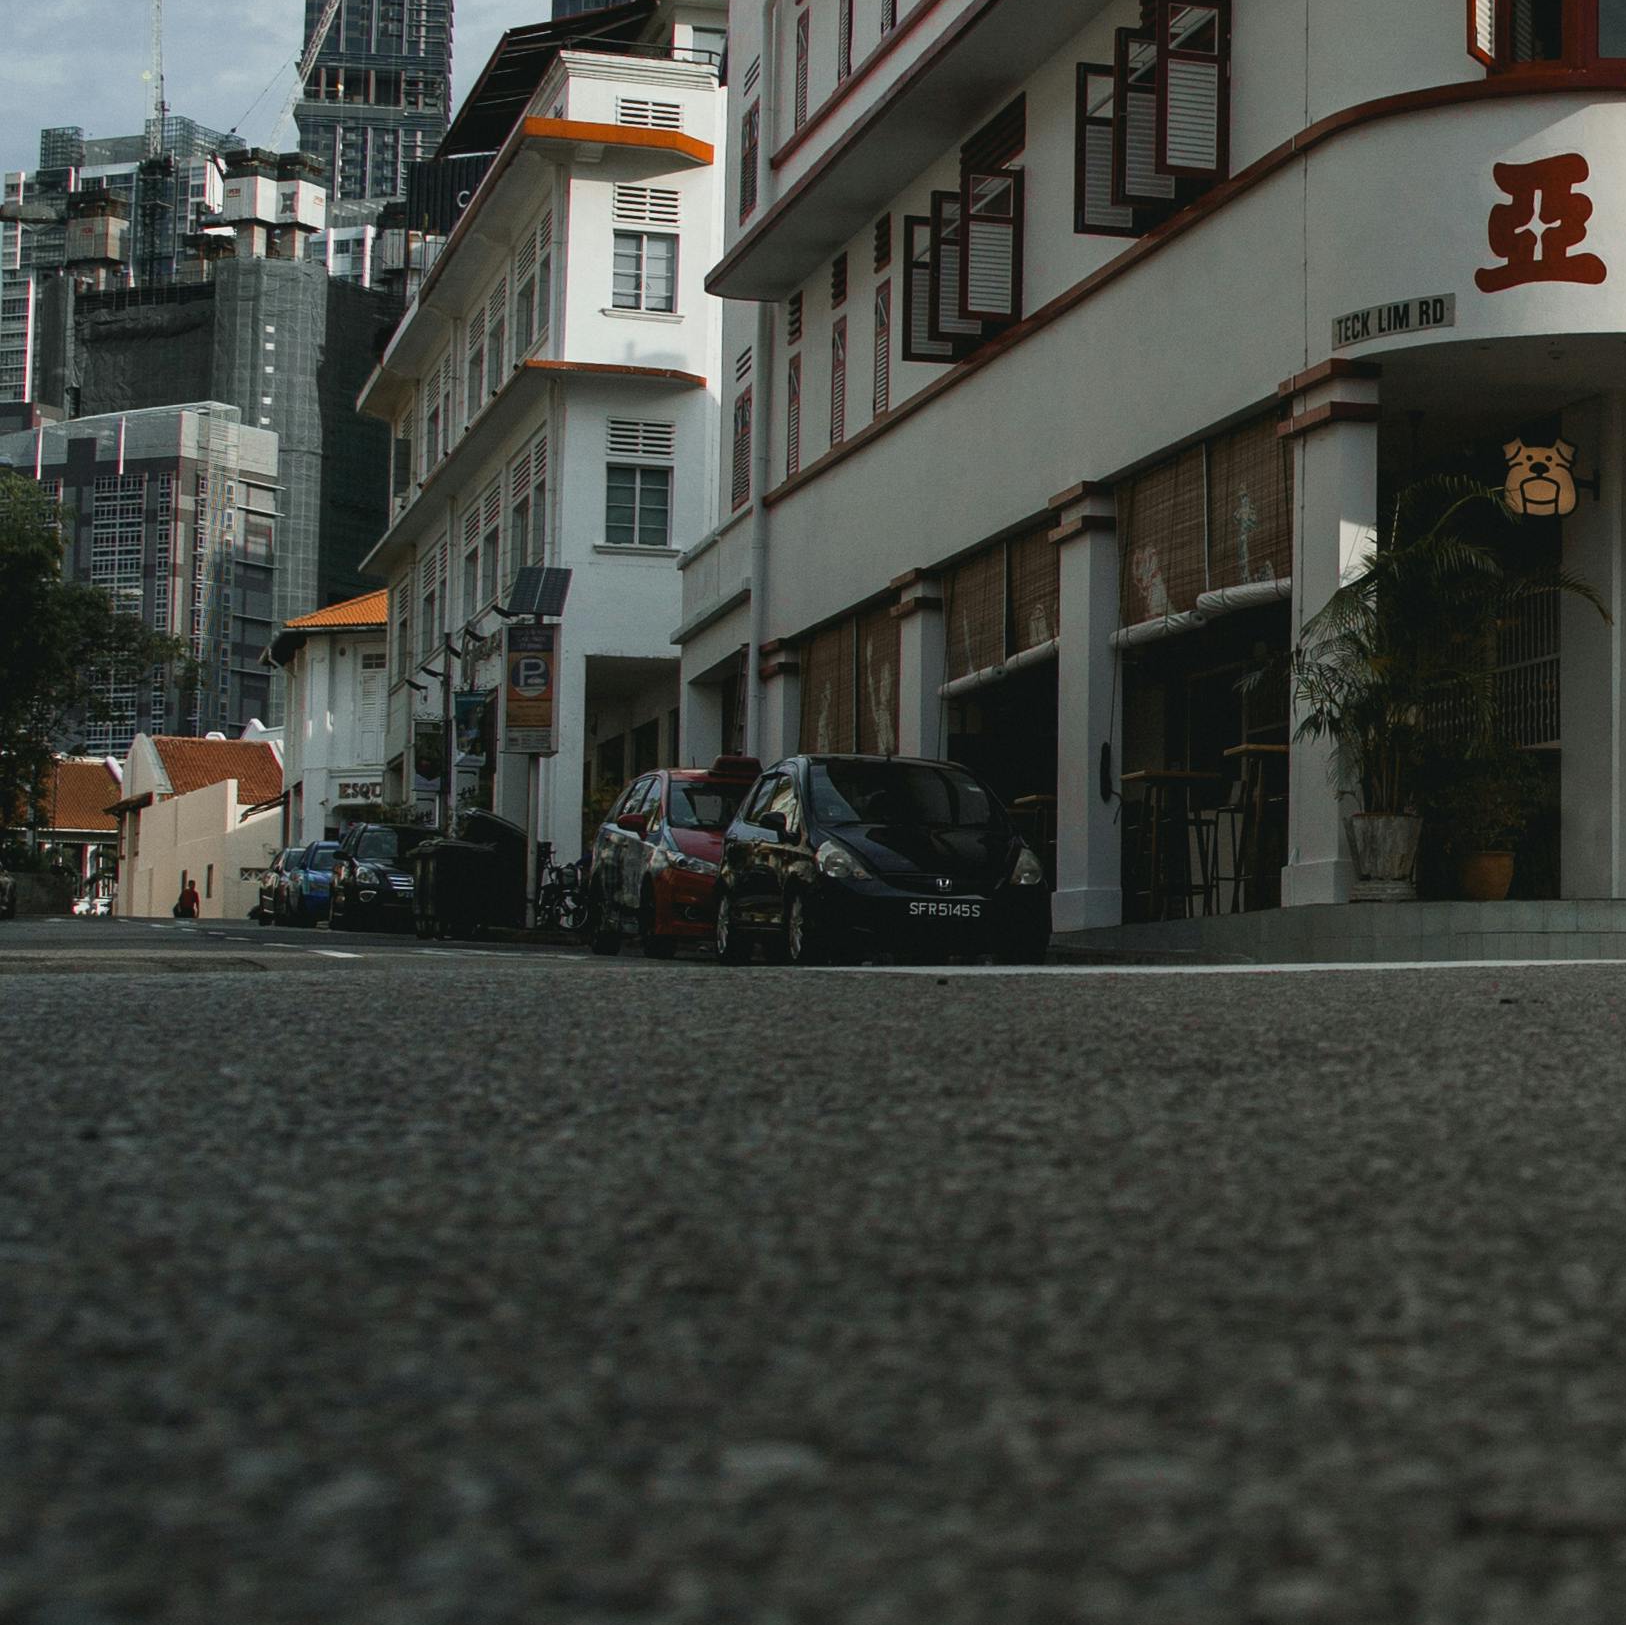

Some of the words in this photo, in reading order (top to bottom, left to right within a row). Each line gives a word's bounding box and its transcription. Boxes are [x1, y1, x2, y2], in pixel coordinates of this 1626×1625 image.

[1337, 311, 1371, 344] TECK
[1378, 303, 1410, 333] LIM
[1419, 298, 1444, 326] RD
[909, 902, 981, 917] SFR5145S
